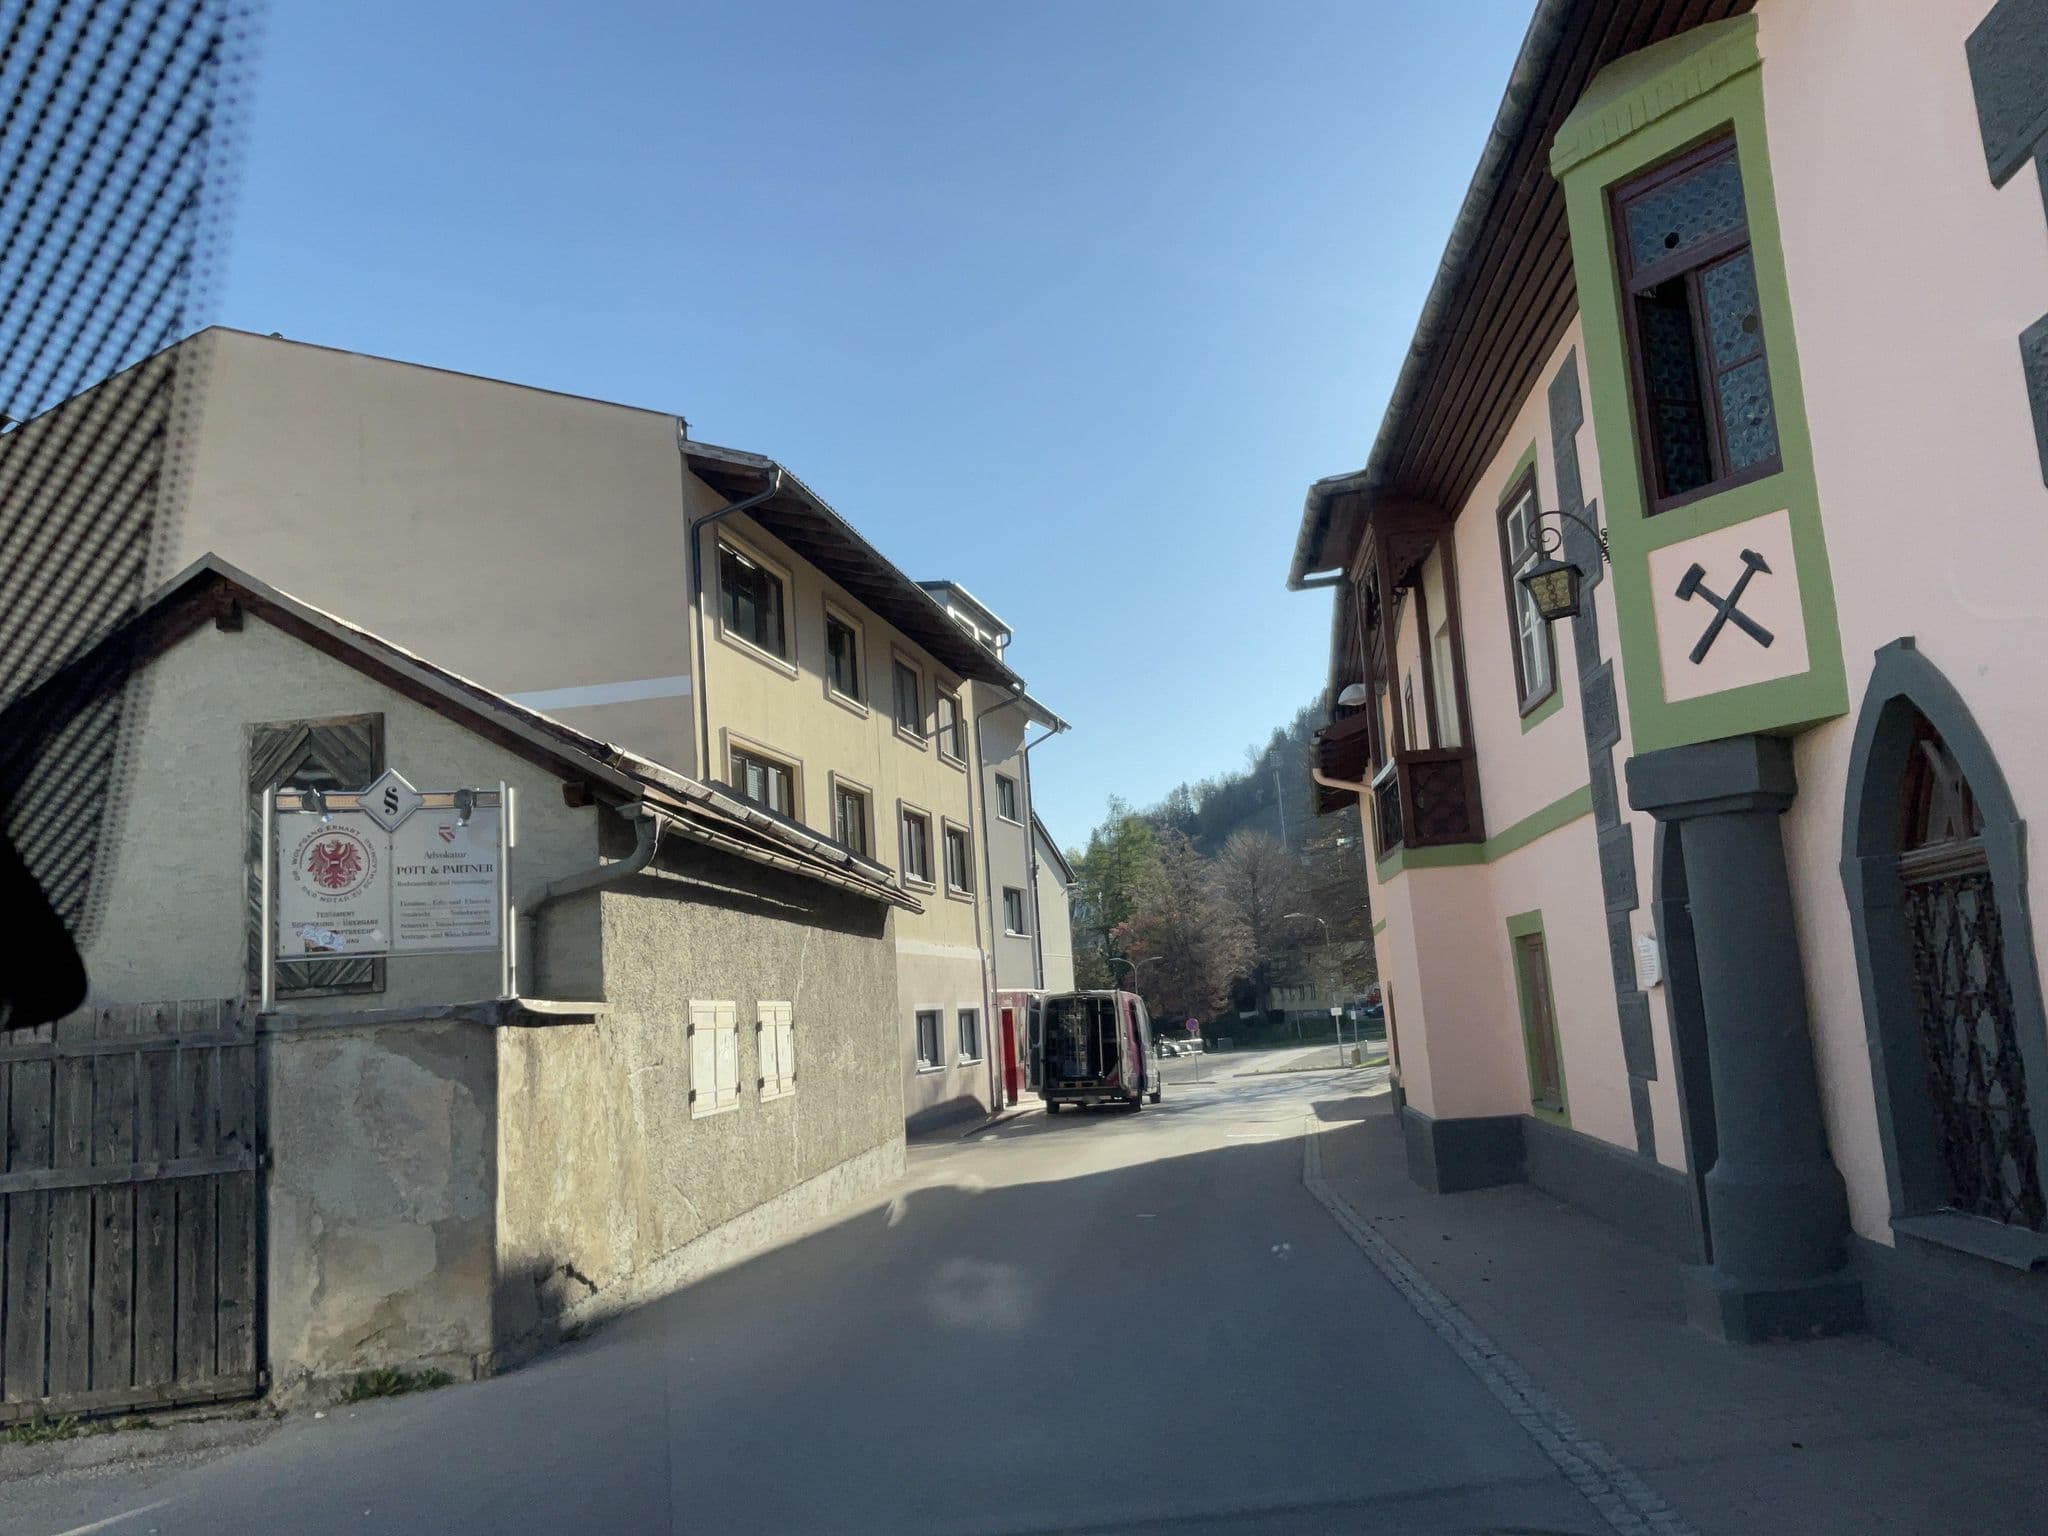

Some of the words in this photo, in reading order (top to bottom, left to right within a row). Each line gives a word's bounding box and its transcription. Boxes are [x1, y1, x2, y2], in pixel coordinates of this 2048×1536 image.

[291, 827, 324, 866] WOLFGANG
[425, 850, 468, 860] Advokatur
[396, 865, 426, 875] POTT
[430, 866, 440, 875] &
[442, 863, 494, 874] PARTNER
[316, 911, 355, 919] TESTAMENT
